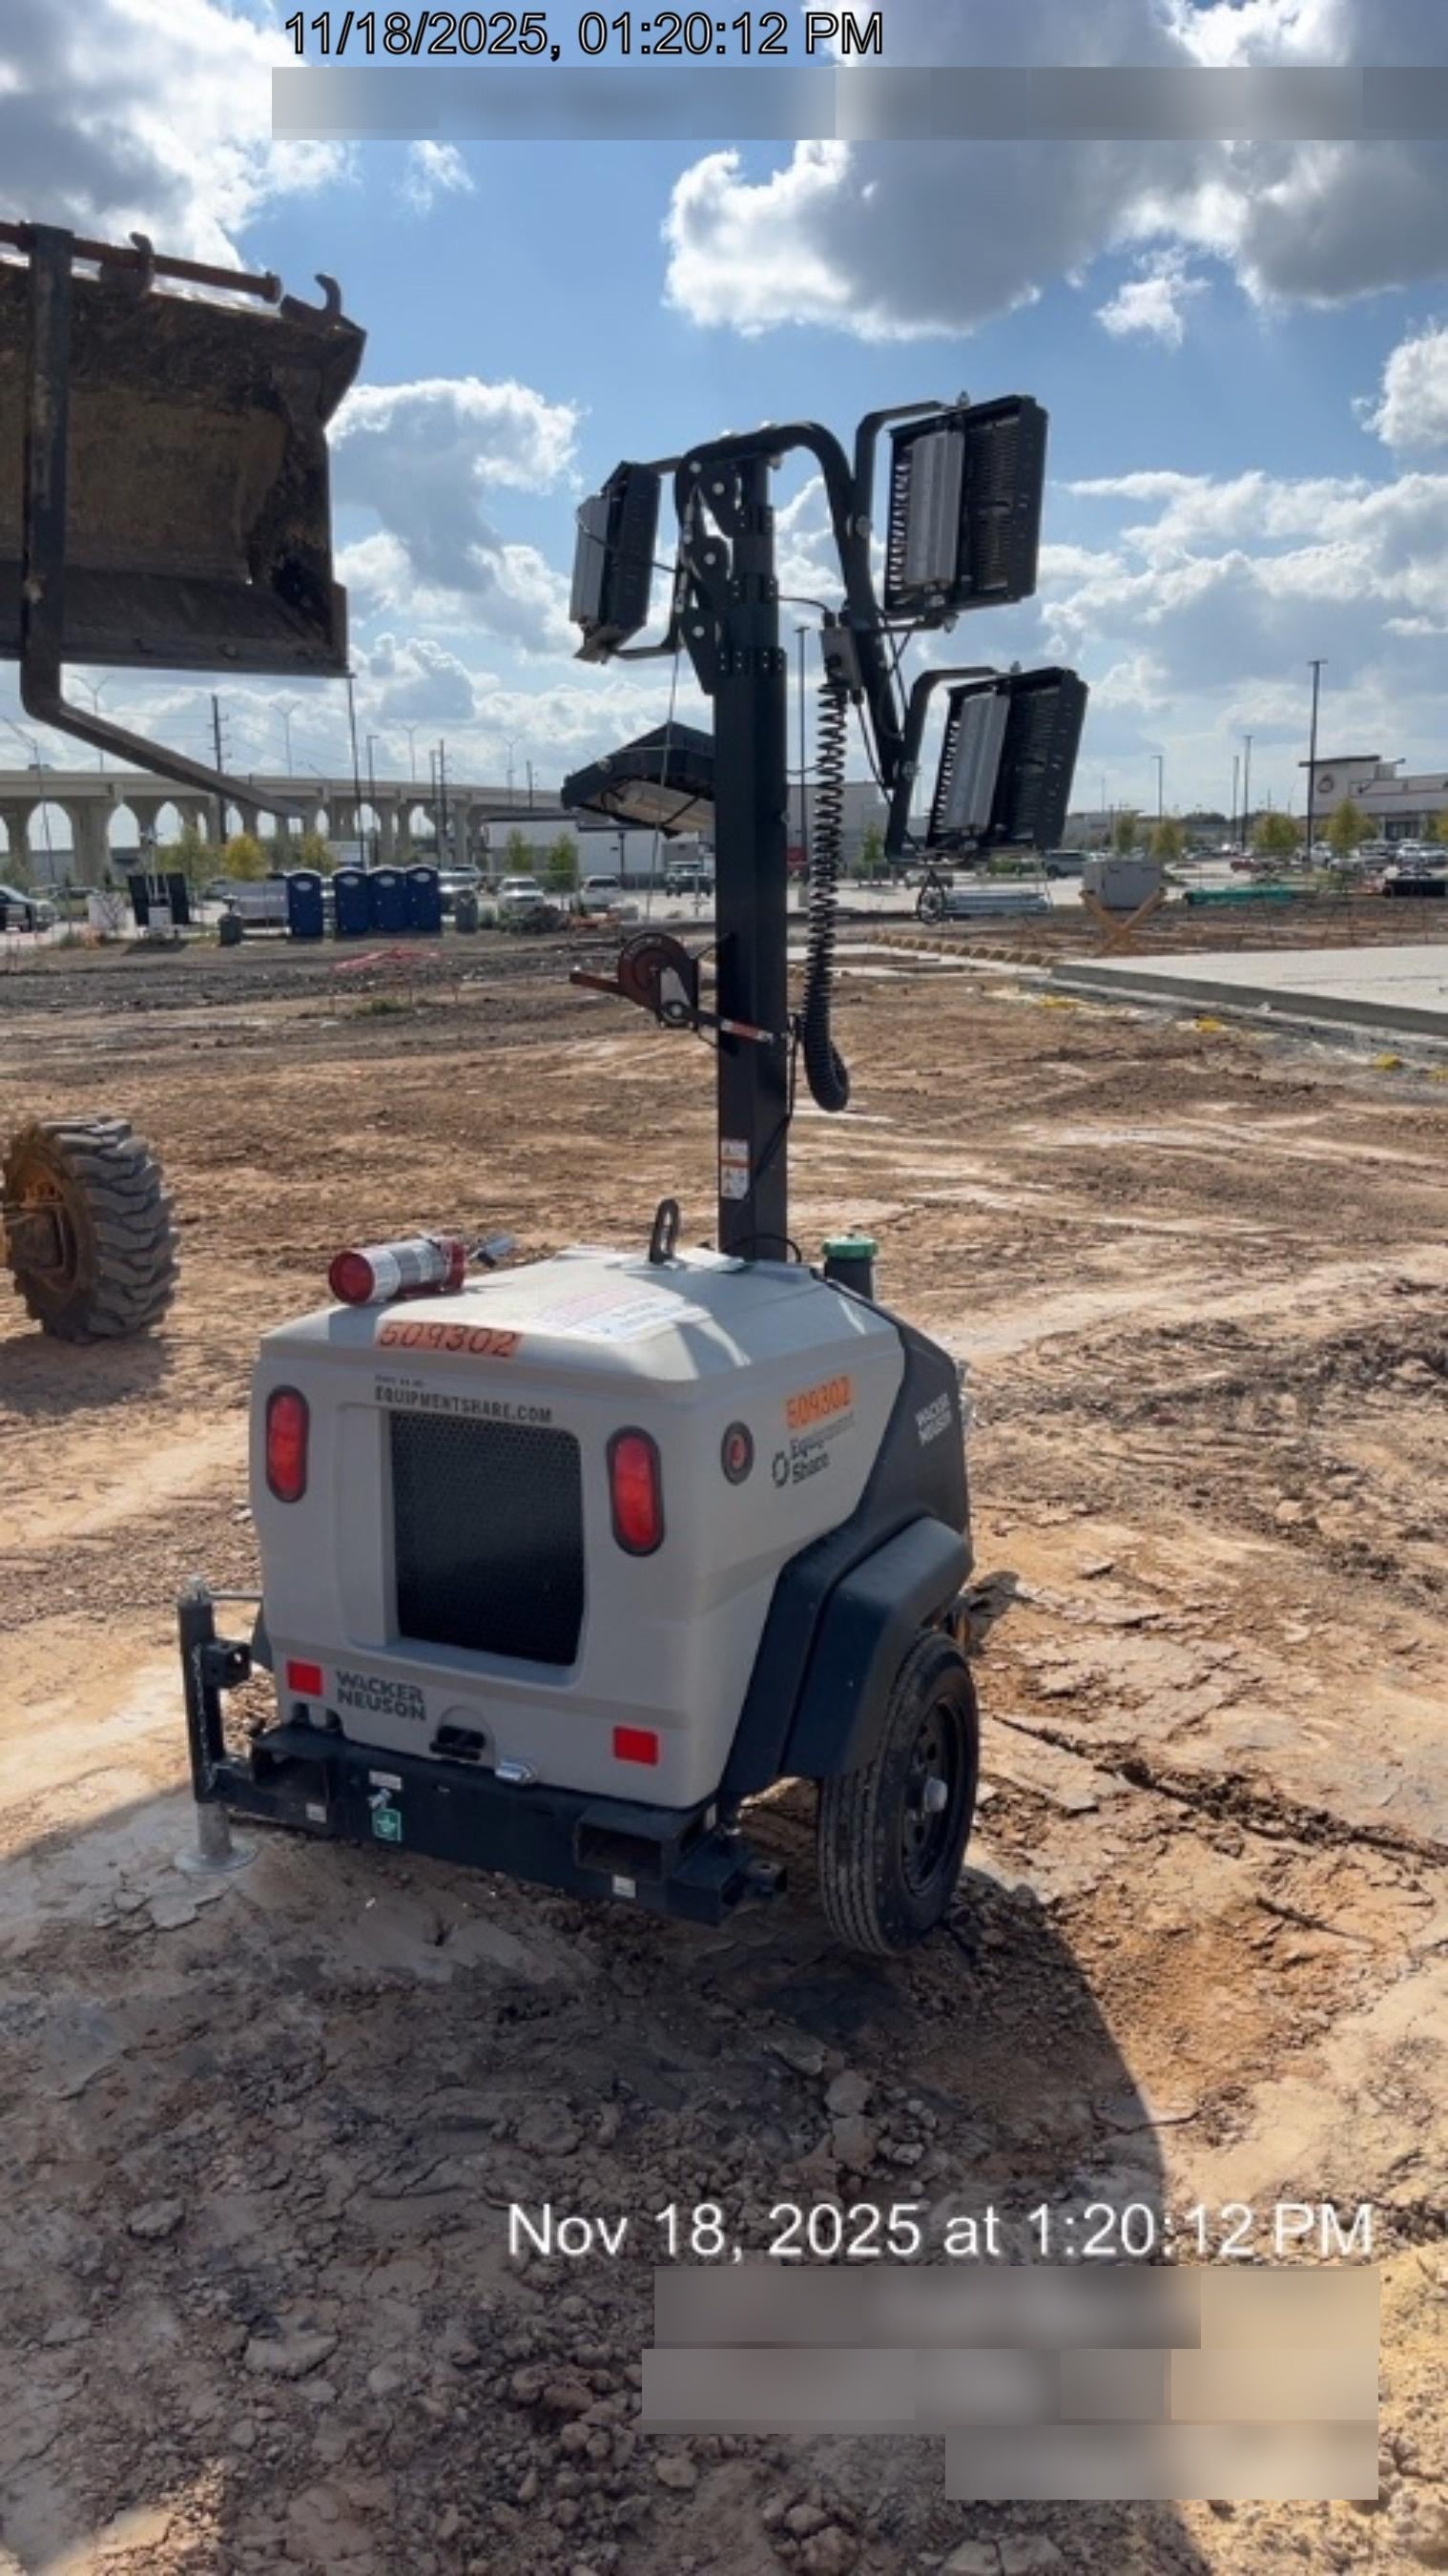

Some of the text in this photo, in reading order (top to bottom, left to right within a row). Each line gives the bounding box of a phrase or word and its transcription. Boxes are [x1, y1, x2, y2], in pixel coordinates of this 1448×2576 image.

[374, 1385, 553, 1423] EQUIPMENTSHARE.COM
[335, 1670, 424, 1703] WACKER
[337, 1688, 427, 1721] NEUSON
